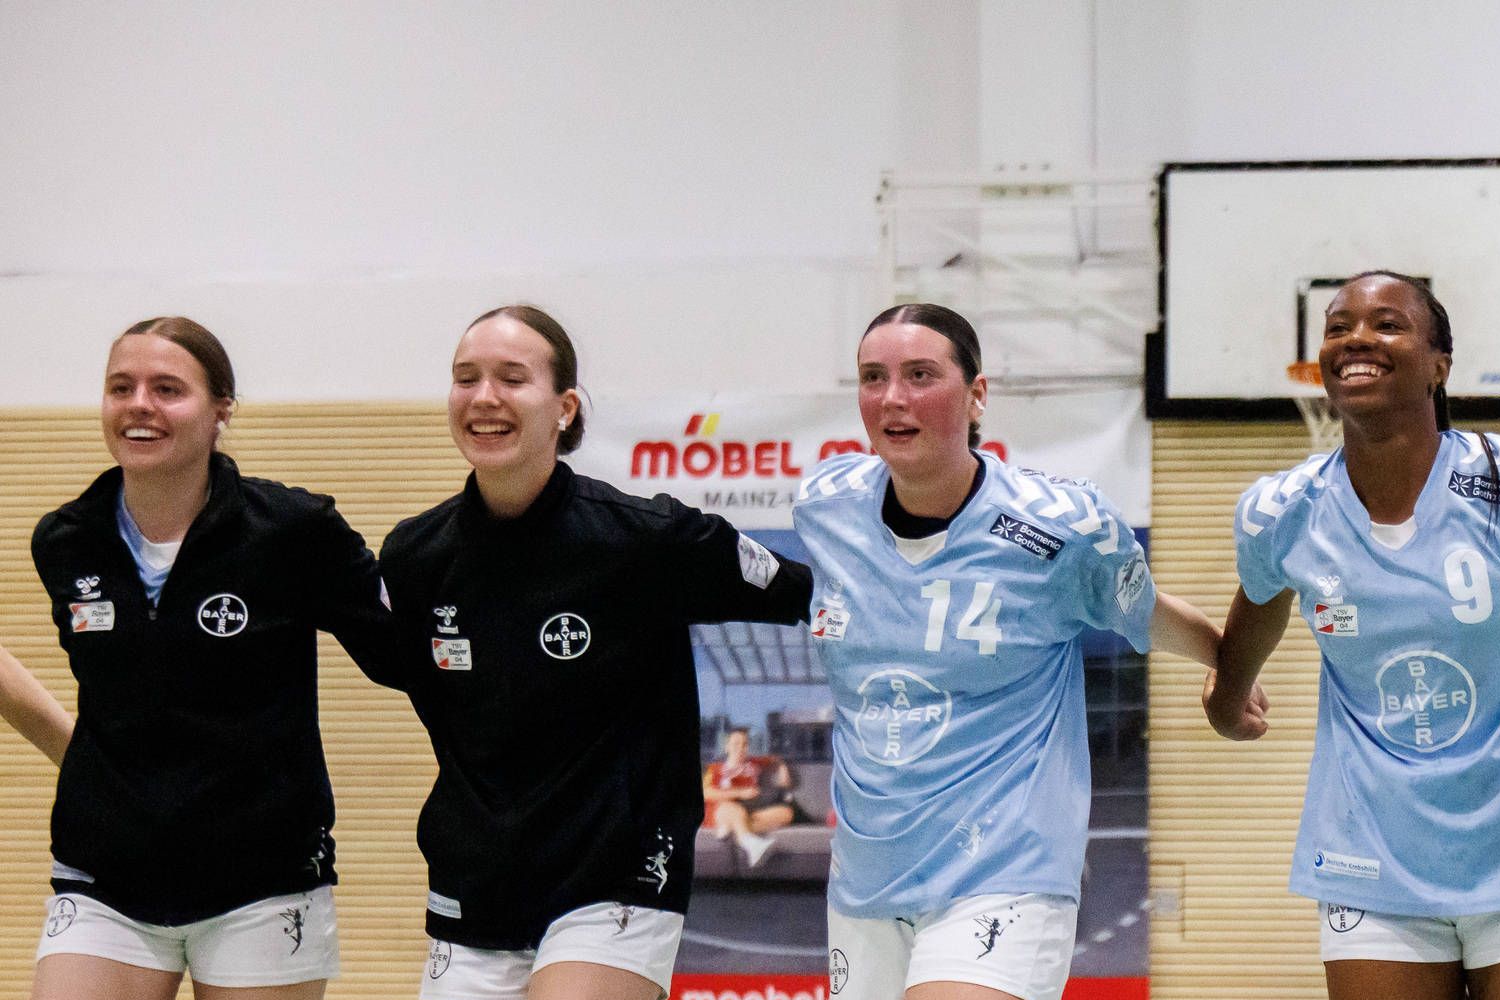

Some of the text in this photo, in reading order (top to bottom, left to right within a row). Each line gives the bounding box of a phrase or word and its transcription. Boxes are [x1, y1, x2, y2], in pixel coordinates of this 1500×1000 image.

[704, 490, 796, 507] MAINZ-
[1014, 534, 1051, 558] Gothaer
[1019, 524, 1062, 551] Barmenia
[1443, 548, 1493, 625] 9
[202, 609, 245, 621] BAYER
[217, 597, 230, 634] BAYER
[921, 579, 1003, 655] 14
[1333, 614, 1354, 622] Bayer
[544, 631, 587, 642] BAYER
[561, 617, 571, 656] BAYER
[1387, 690, 1468, 712] BAYER
[1407, 660, 1433, 745] BAYER
